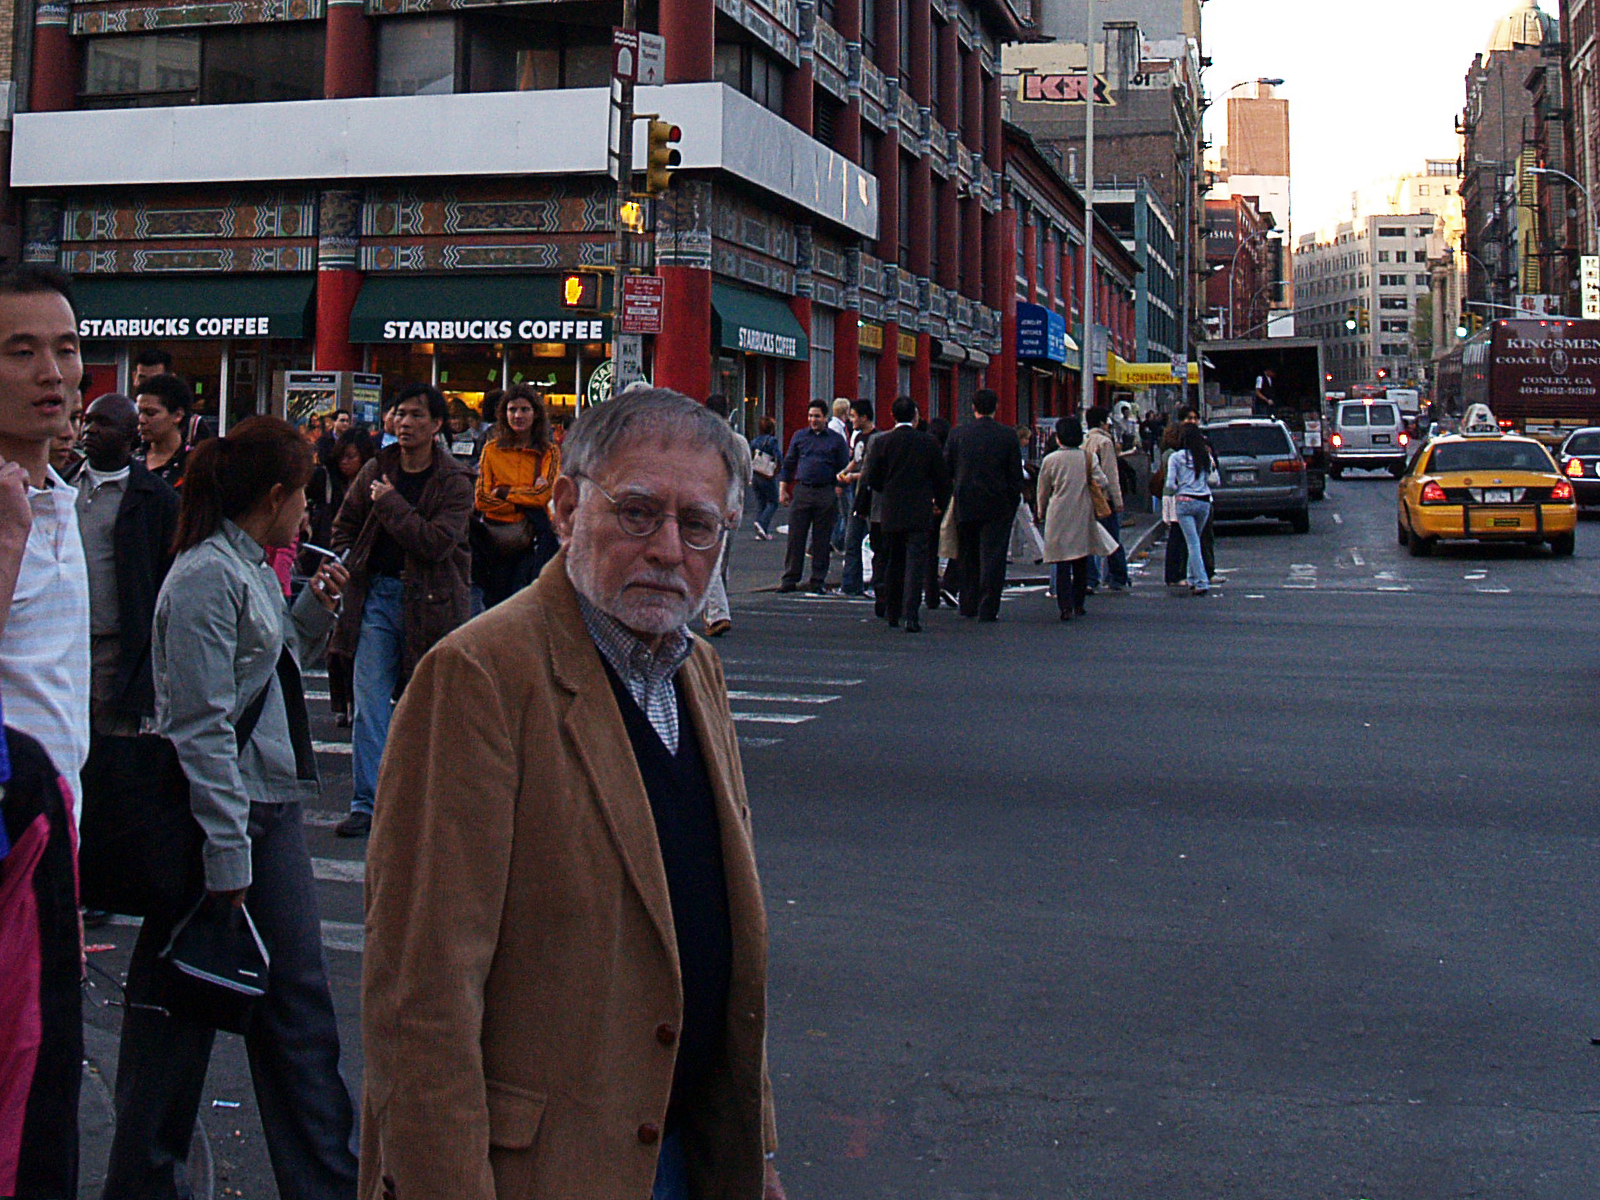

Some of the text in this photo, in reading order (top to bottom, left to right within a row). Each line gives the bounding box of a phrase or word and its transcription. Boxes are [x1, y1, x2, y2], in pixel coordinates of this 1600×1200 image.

[79, 317, 270, 337] STARBUCKS COFFEE
[383, 320, 512, 340] STARBUCKS
[518, 320, 603, 340] COFFEE
[738, 326, 796, 357] STARBUCKS COFFEE
[1495, 356, 1546, 365] COACH
[1574, 377, 1592, 385] GA
